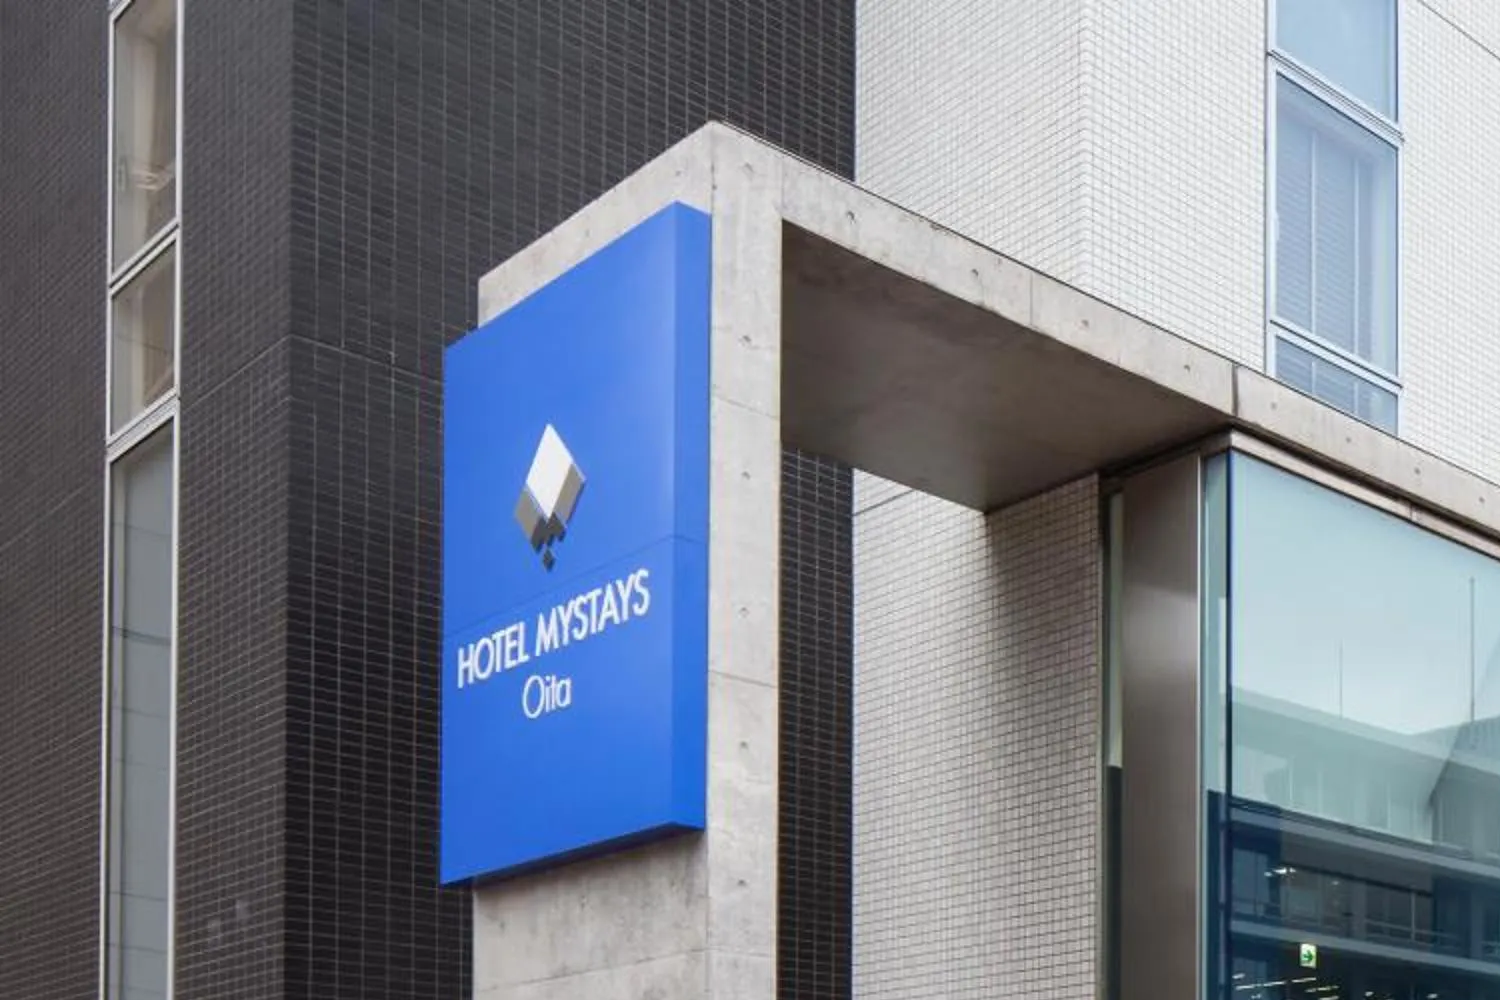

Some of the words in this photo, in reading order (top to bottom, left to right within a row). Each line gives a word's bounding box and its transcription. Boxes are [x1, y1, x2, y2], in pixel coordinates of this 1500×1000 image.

[457, 622, 529, 689] HOTEL
[535, 568, 650, 658] MYSTAYS
[522, 675, 572, 719] Oita
